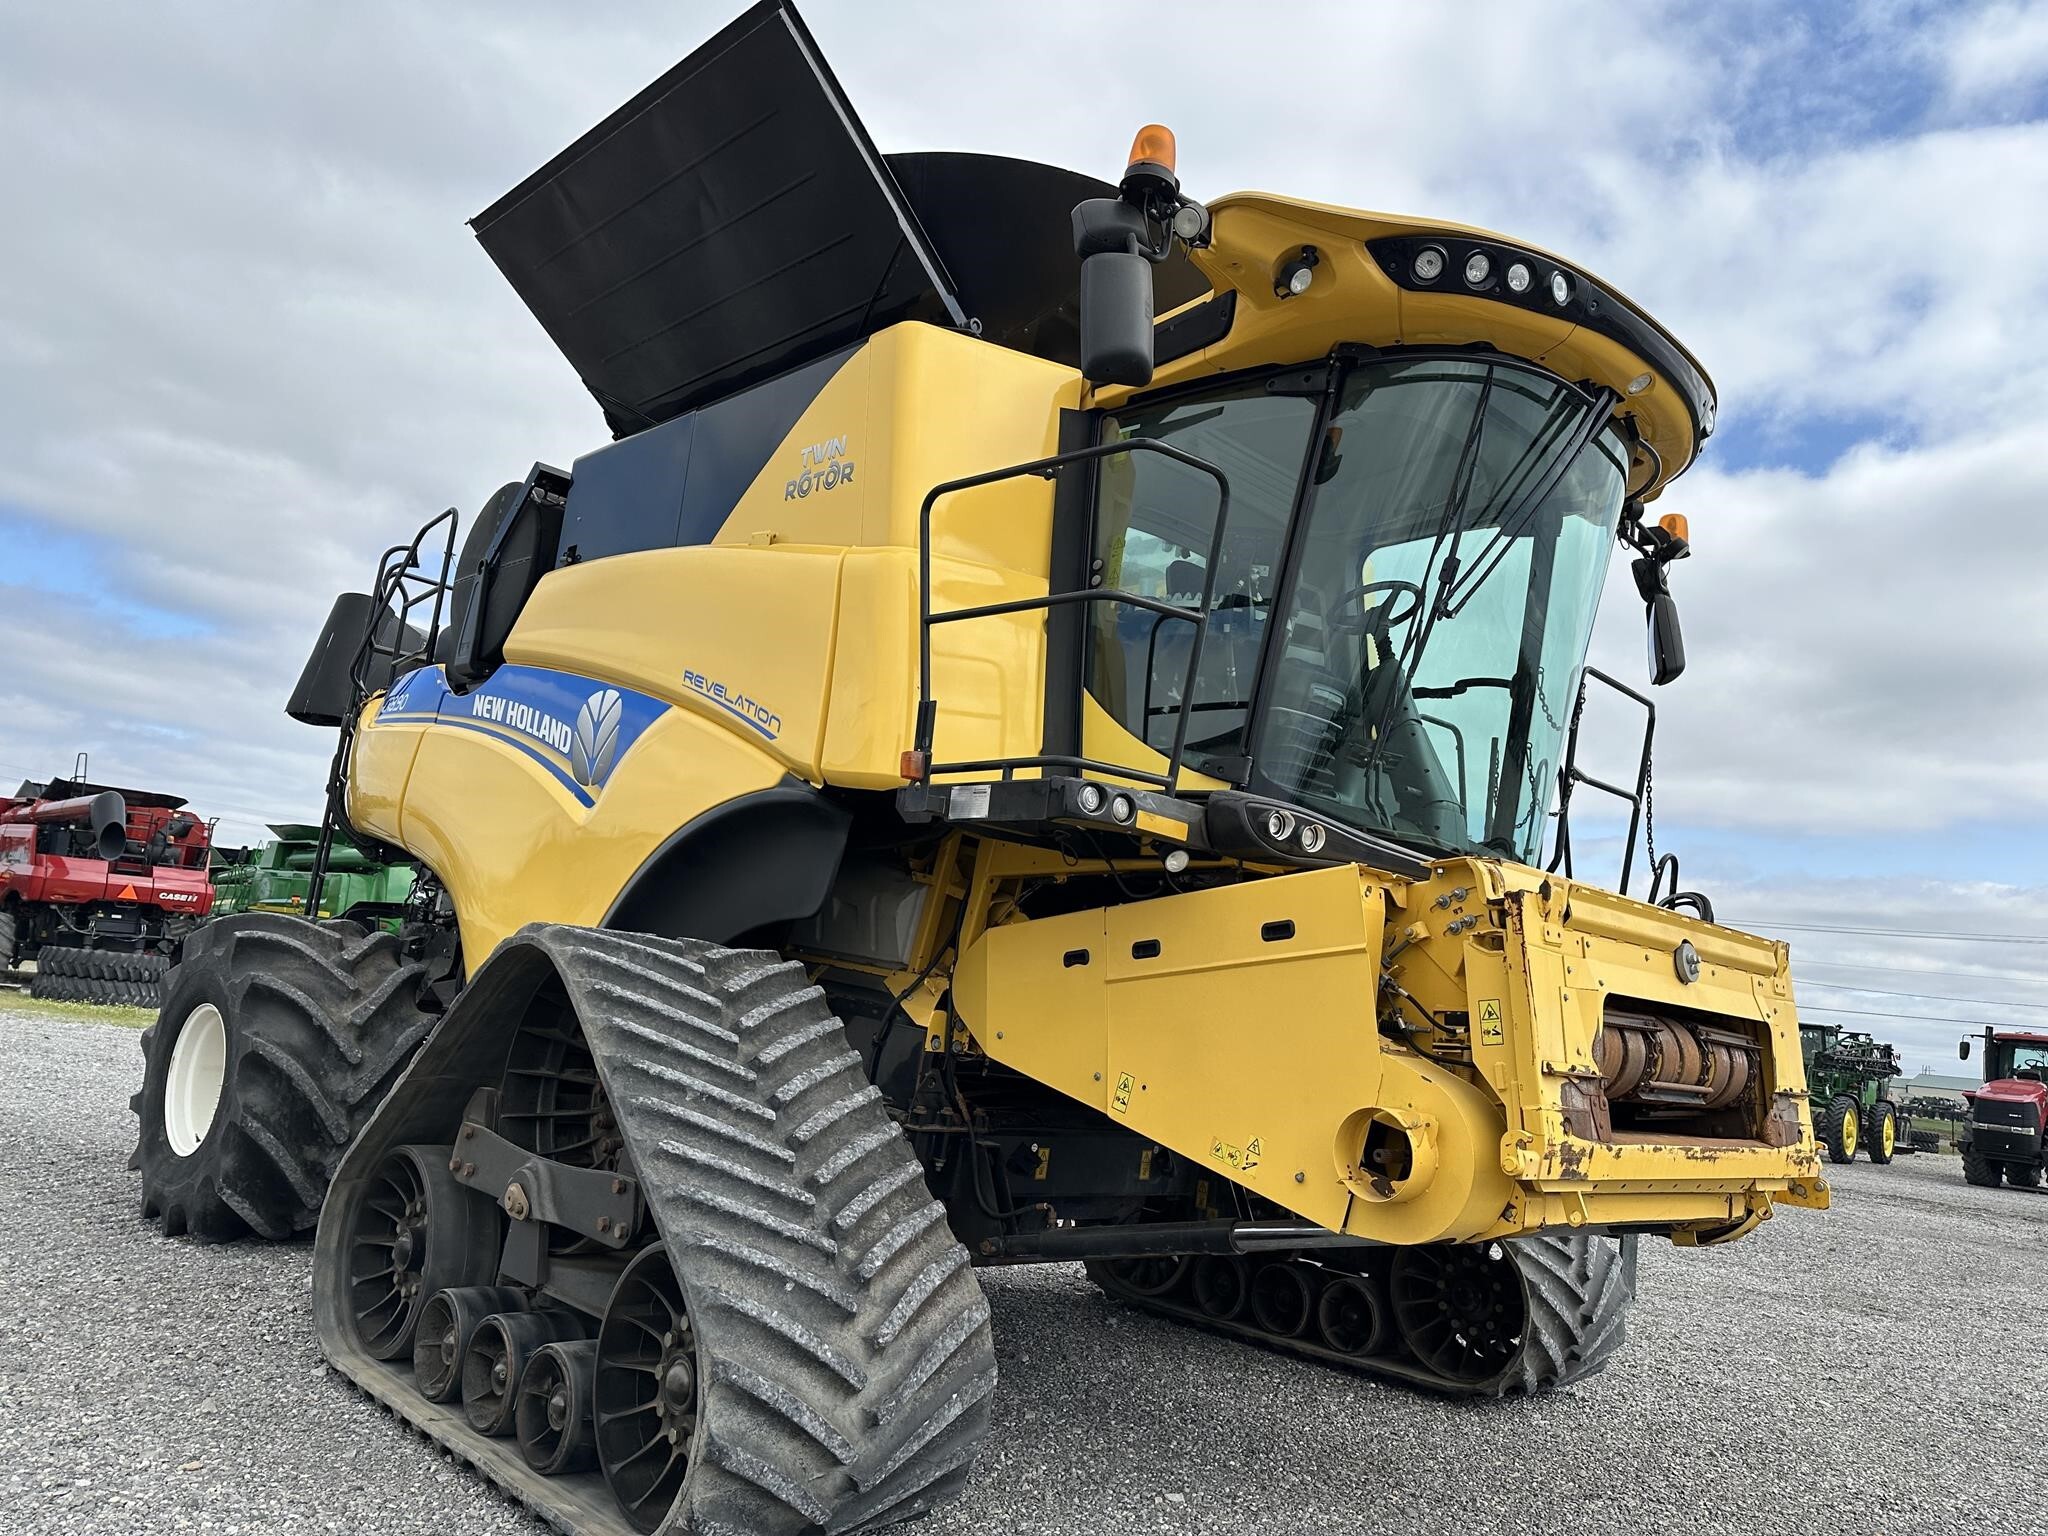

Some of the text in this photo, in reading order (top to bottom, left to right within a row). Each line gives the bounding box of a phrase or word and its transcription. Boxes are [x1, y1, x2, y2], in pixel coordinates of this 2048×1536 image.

[801, 434, 847, 468] TWIN
[785, 459, 854, 501] ROTOR
[683, 670, 781, 733] REVELATION
[472, 694, 572, 754] NEW HOLLAND
[159, 892, 188, 902] CASE
